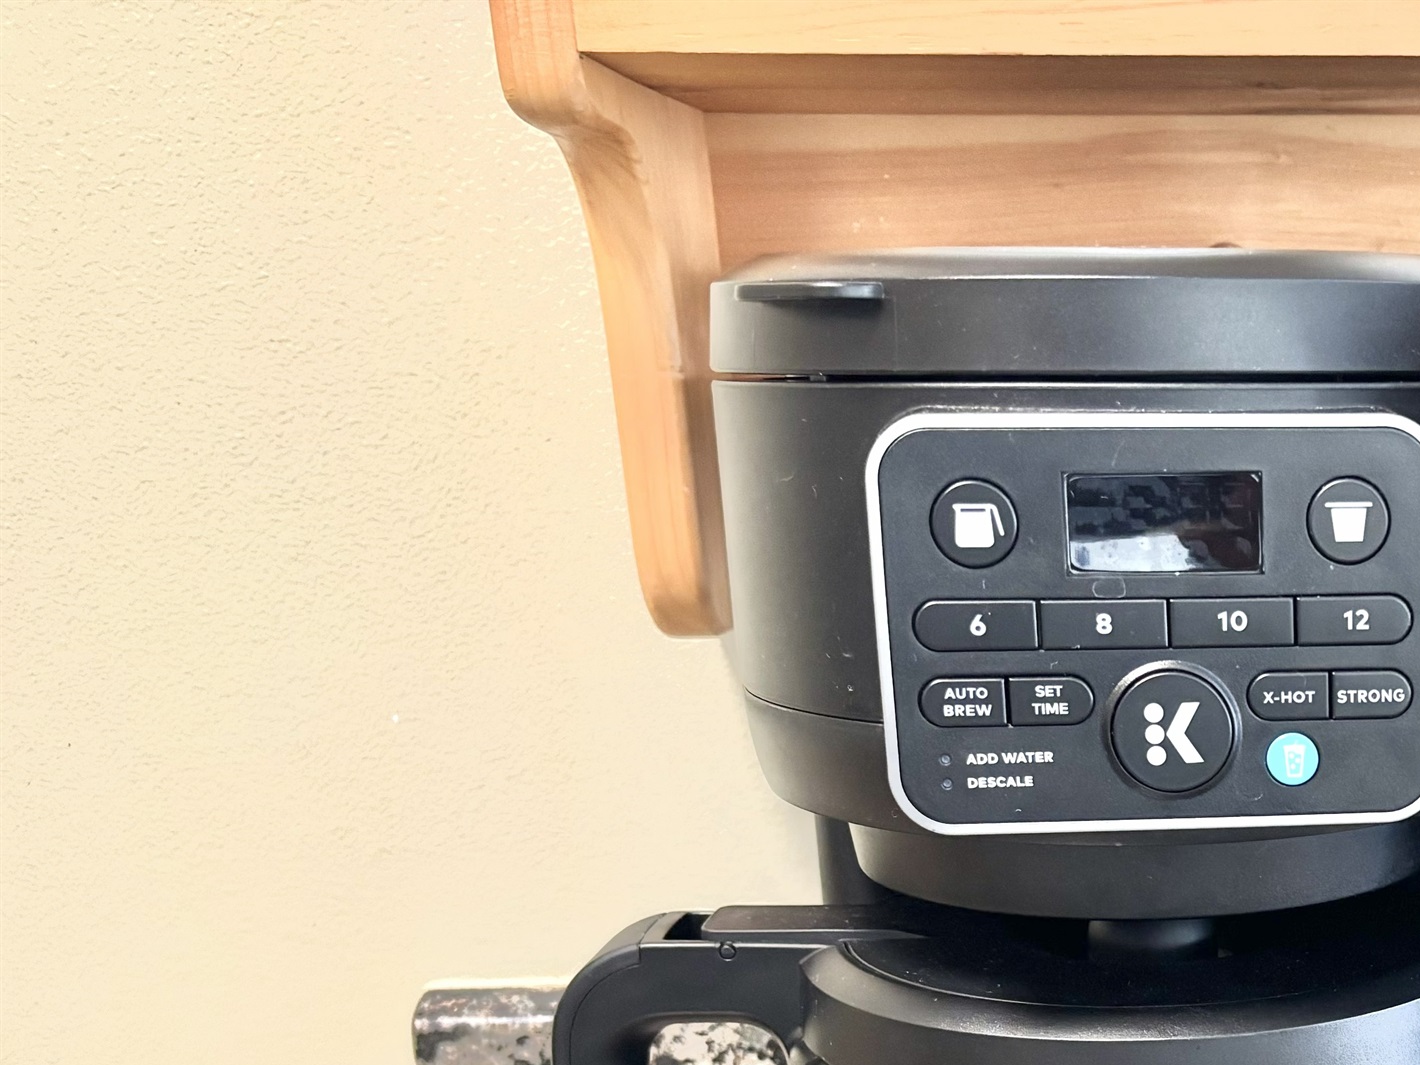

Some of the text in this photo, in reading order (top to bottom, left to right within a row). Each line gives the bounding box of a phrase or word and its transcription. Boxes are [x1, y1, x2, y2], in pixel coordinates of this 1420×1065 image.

[970, 614, 987, 636] 6
[1095, 613, 1113, 635] 8
[1217, 611, 1248, 632] 10
[1344, 610, 1371, 631] 12
[944, 687, 988, 700] AUTO
[1034, 685, 1063, 698] SET
[1263, 690, 1316, 704] X-HOT
[1337, 688, 1405, 704] STRONG
[943, 704, 992, 717] BREW
[1031, 702, 1069, 715] TIME
[966, 751, 1054, 765] ADD WATER
[967, 776, 1034, 789] DESCALE
